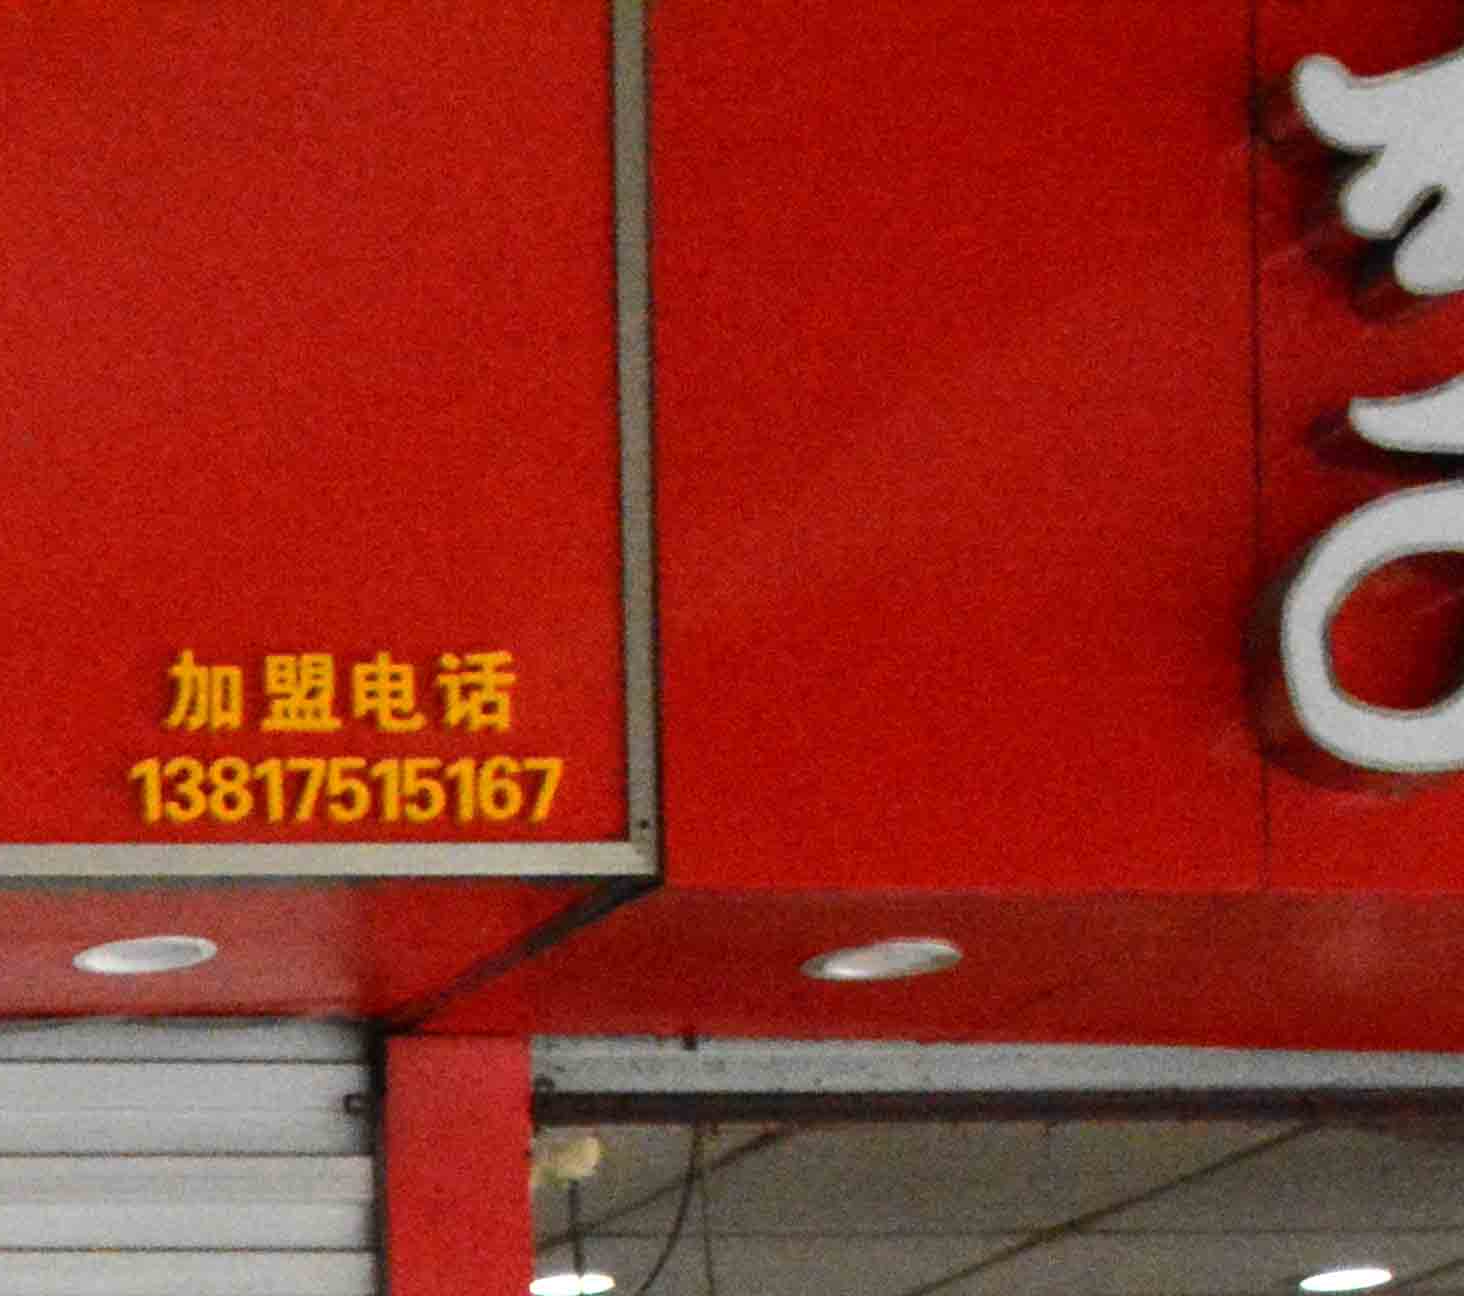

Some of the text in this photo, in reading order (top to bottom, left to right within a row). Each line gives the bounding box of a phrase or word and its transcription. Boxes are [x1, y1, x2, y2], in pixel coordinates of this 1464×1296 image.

[166, 648, 517, 732] 加盟电话
[130, 755, 564, 824] 13817515167
